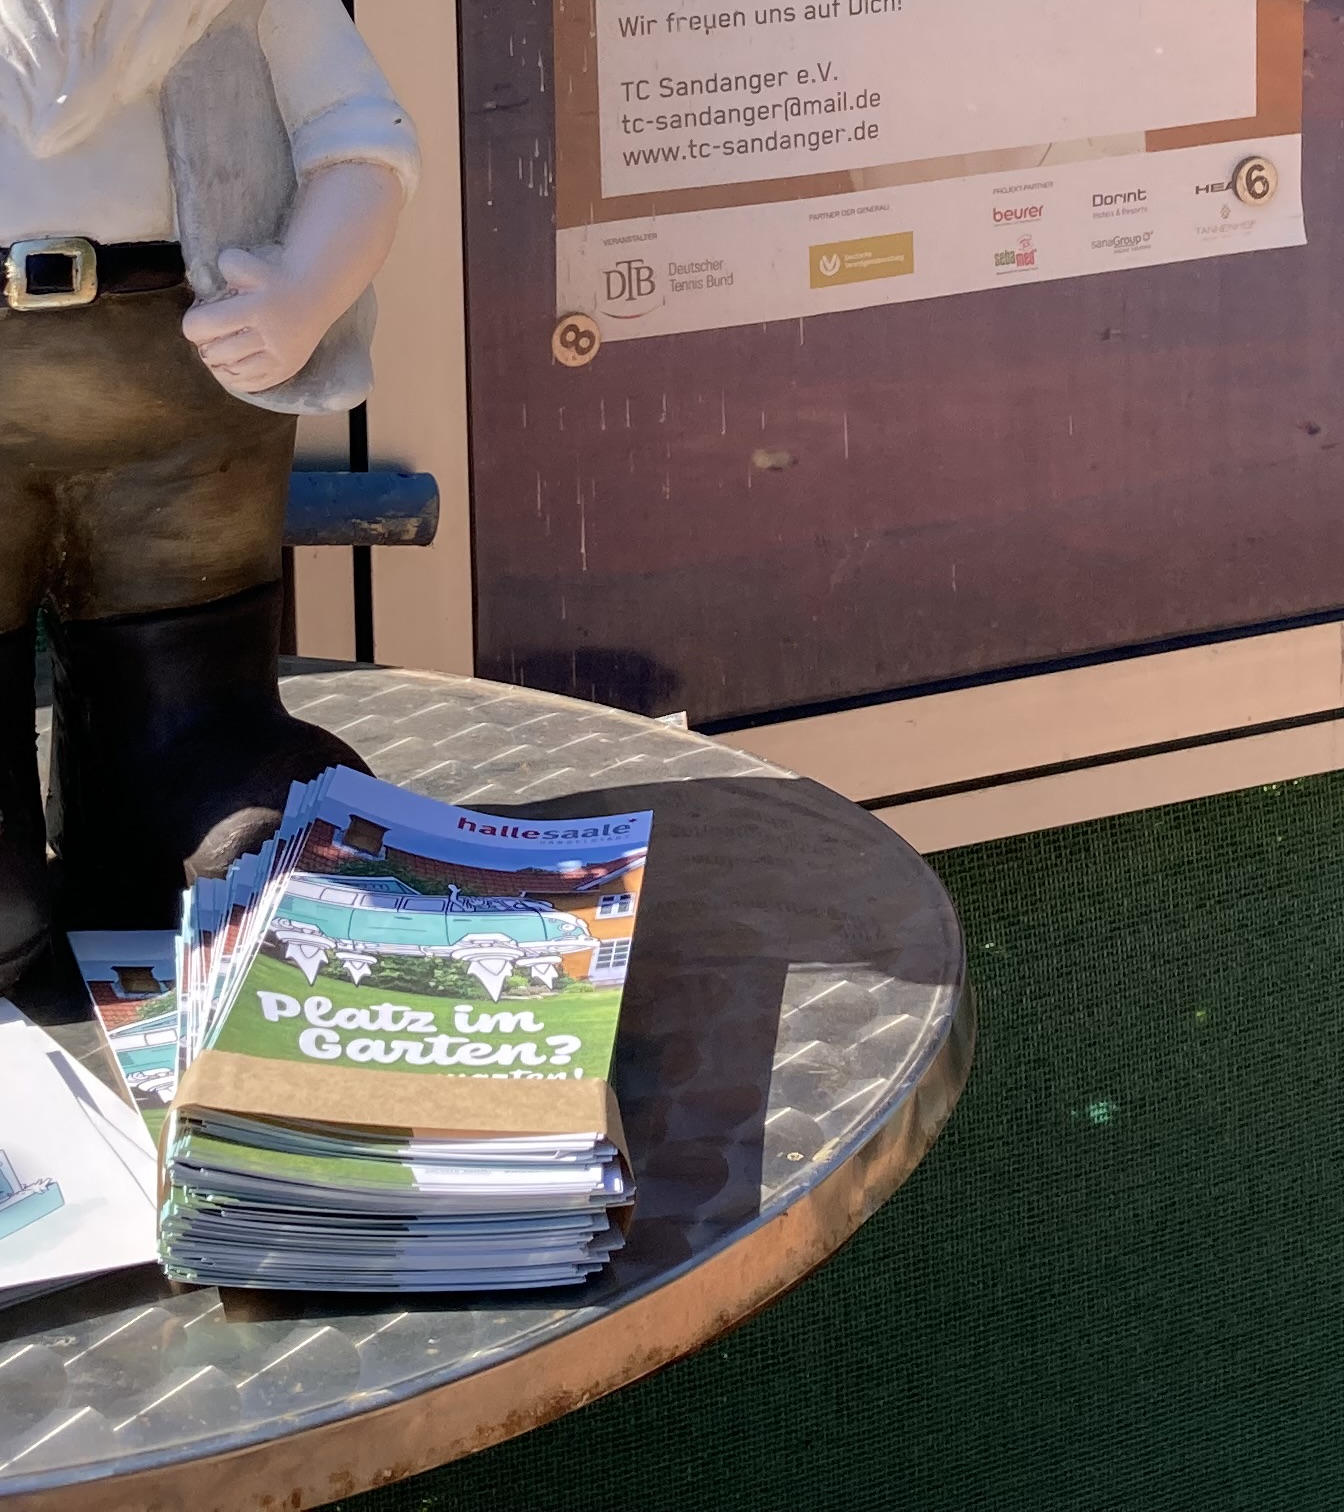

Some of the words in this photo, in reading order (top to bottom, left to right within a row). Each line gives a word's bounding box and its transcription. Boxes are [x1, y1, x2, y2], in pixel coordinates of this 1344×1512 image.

[619, 16, 658, 38] Wir
[666, 10, 746, 34] freuen
[755, 6, 796, 25] uns
[621, 80, 651, 102] TC
[659, 69, 788, 98] Sandanger
[797, 61, 838, 84] e.V.
[622, 88, 881, 135] tc-sandanger@mail.de
[622, 120, 879, 167] www.tc-sandanger.de
[1092, 188, 1147, 208] Dorint
[1245, 163, 1270, 200] 6
[809, 210, 840, 221] PARTNER
[992, 205, 1044, 223] beurer
[603, 258, 656, 302] DTB
[668, 258, 724, 276] Deutscher
[669, 277, 703, 293] Tennis
[706, 272, 734, 289] Bund
[457, 816, 631, 840] hallesaale
[256, 990, 438, 1034] Platz
[454, 1004, 544, 1034] im
[298, 1027, 582, 1066] Garten?
